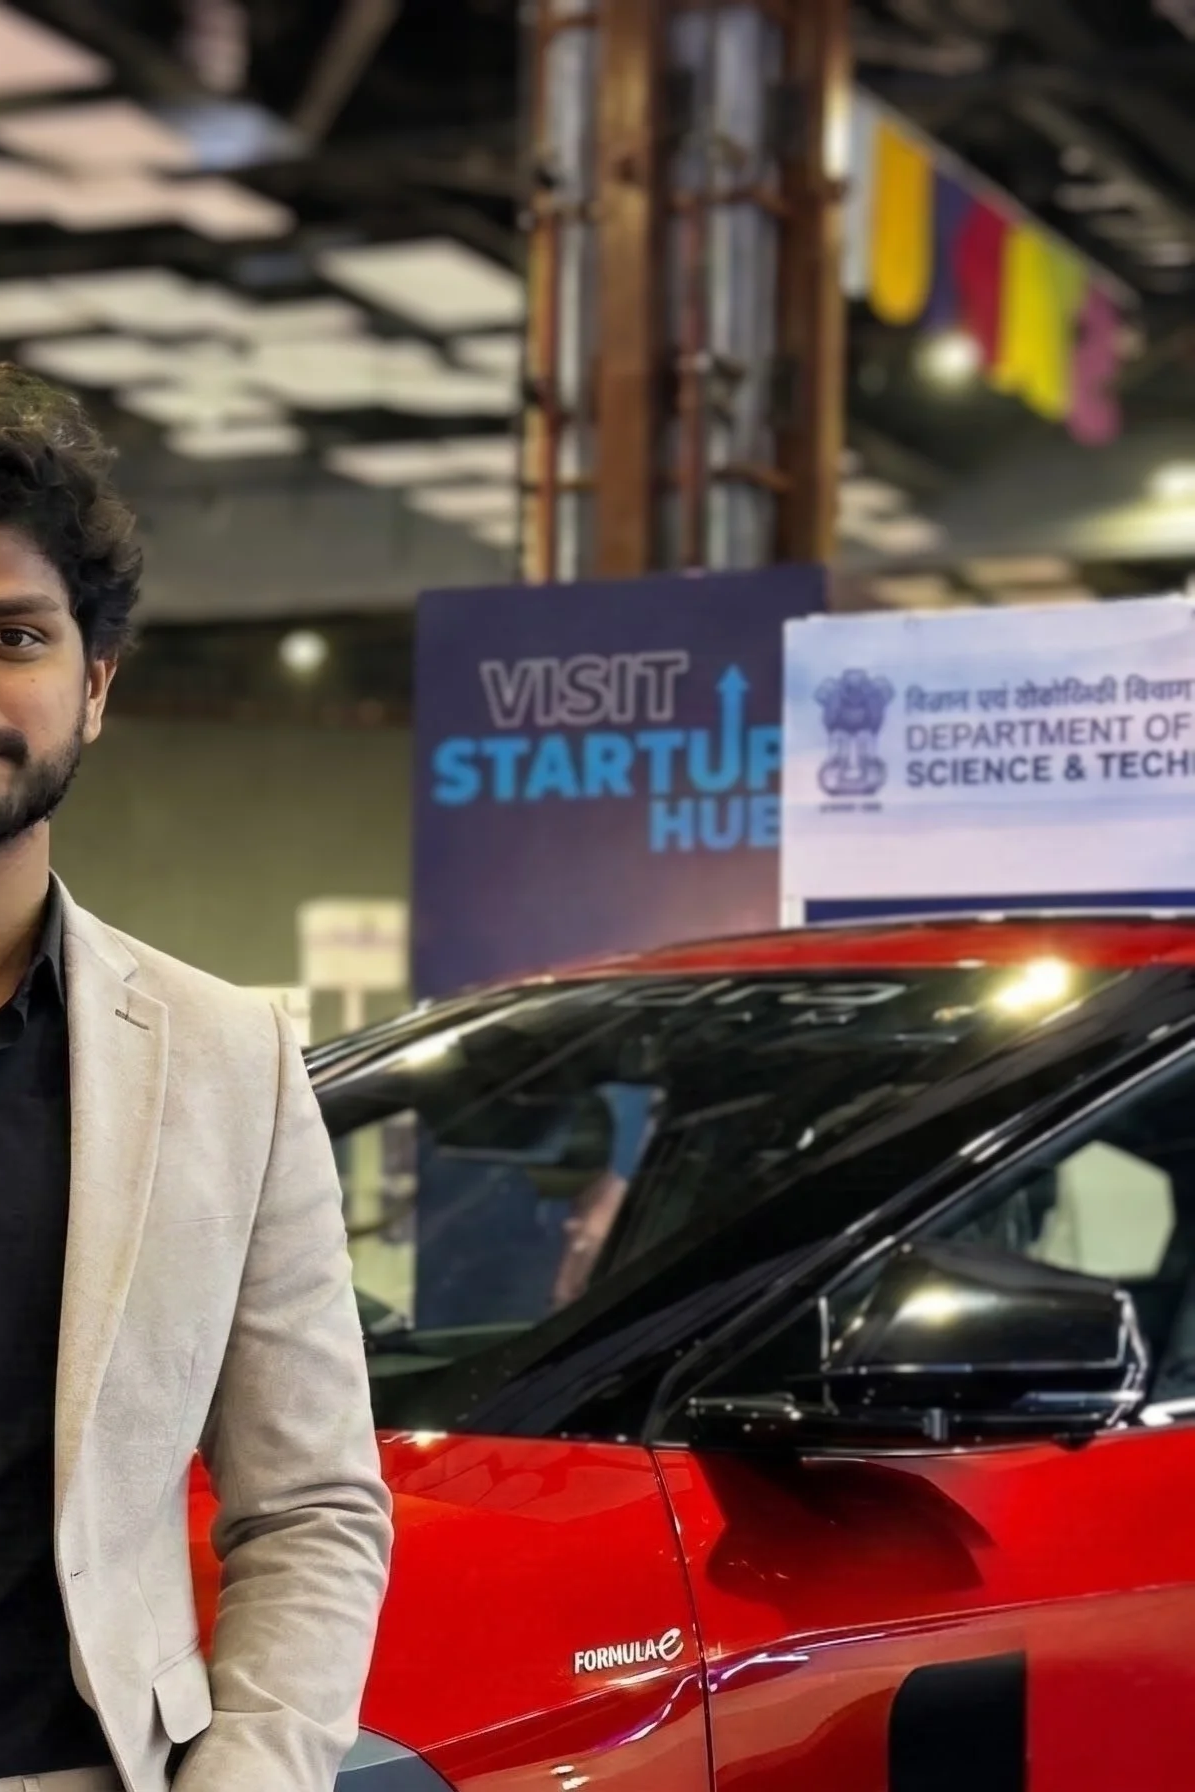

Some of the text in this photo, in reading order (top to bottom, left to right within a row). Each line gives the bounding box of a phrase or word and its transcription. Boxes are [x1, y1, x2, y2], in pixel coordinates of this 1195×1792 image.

[479, 650, 690, 729] VISIT
[906, 713, 1193, 753] DEPARTMENT OF
[906, 748, 1195, 788] SCIENCE & TECH
